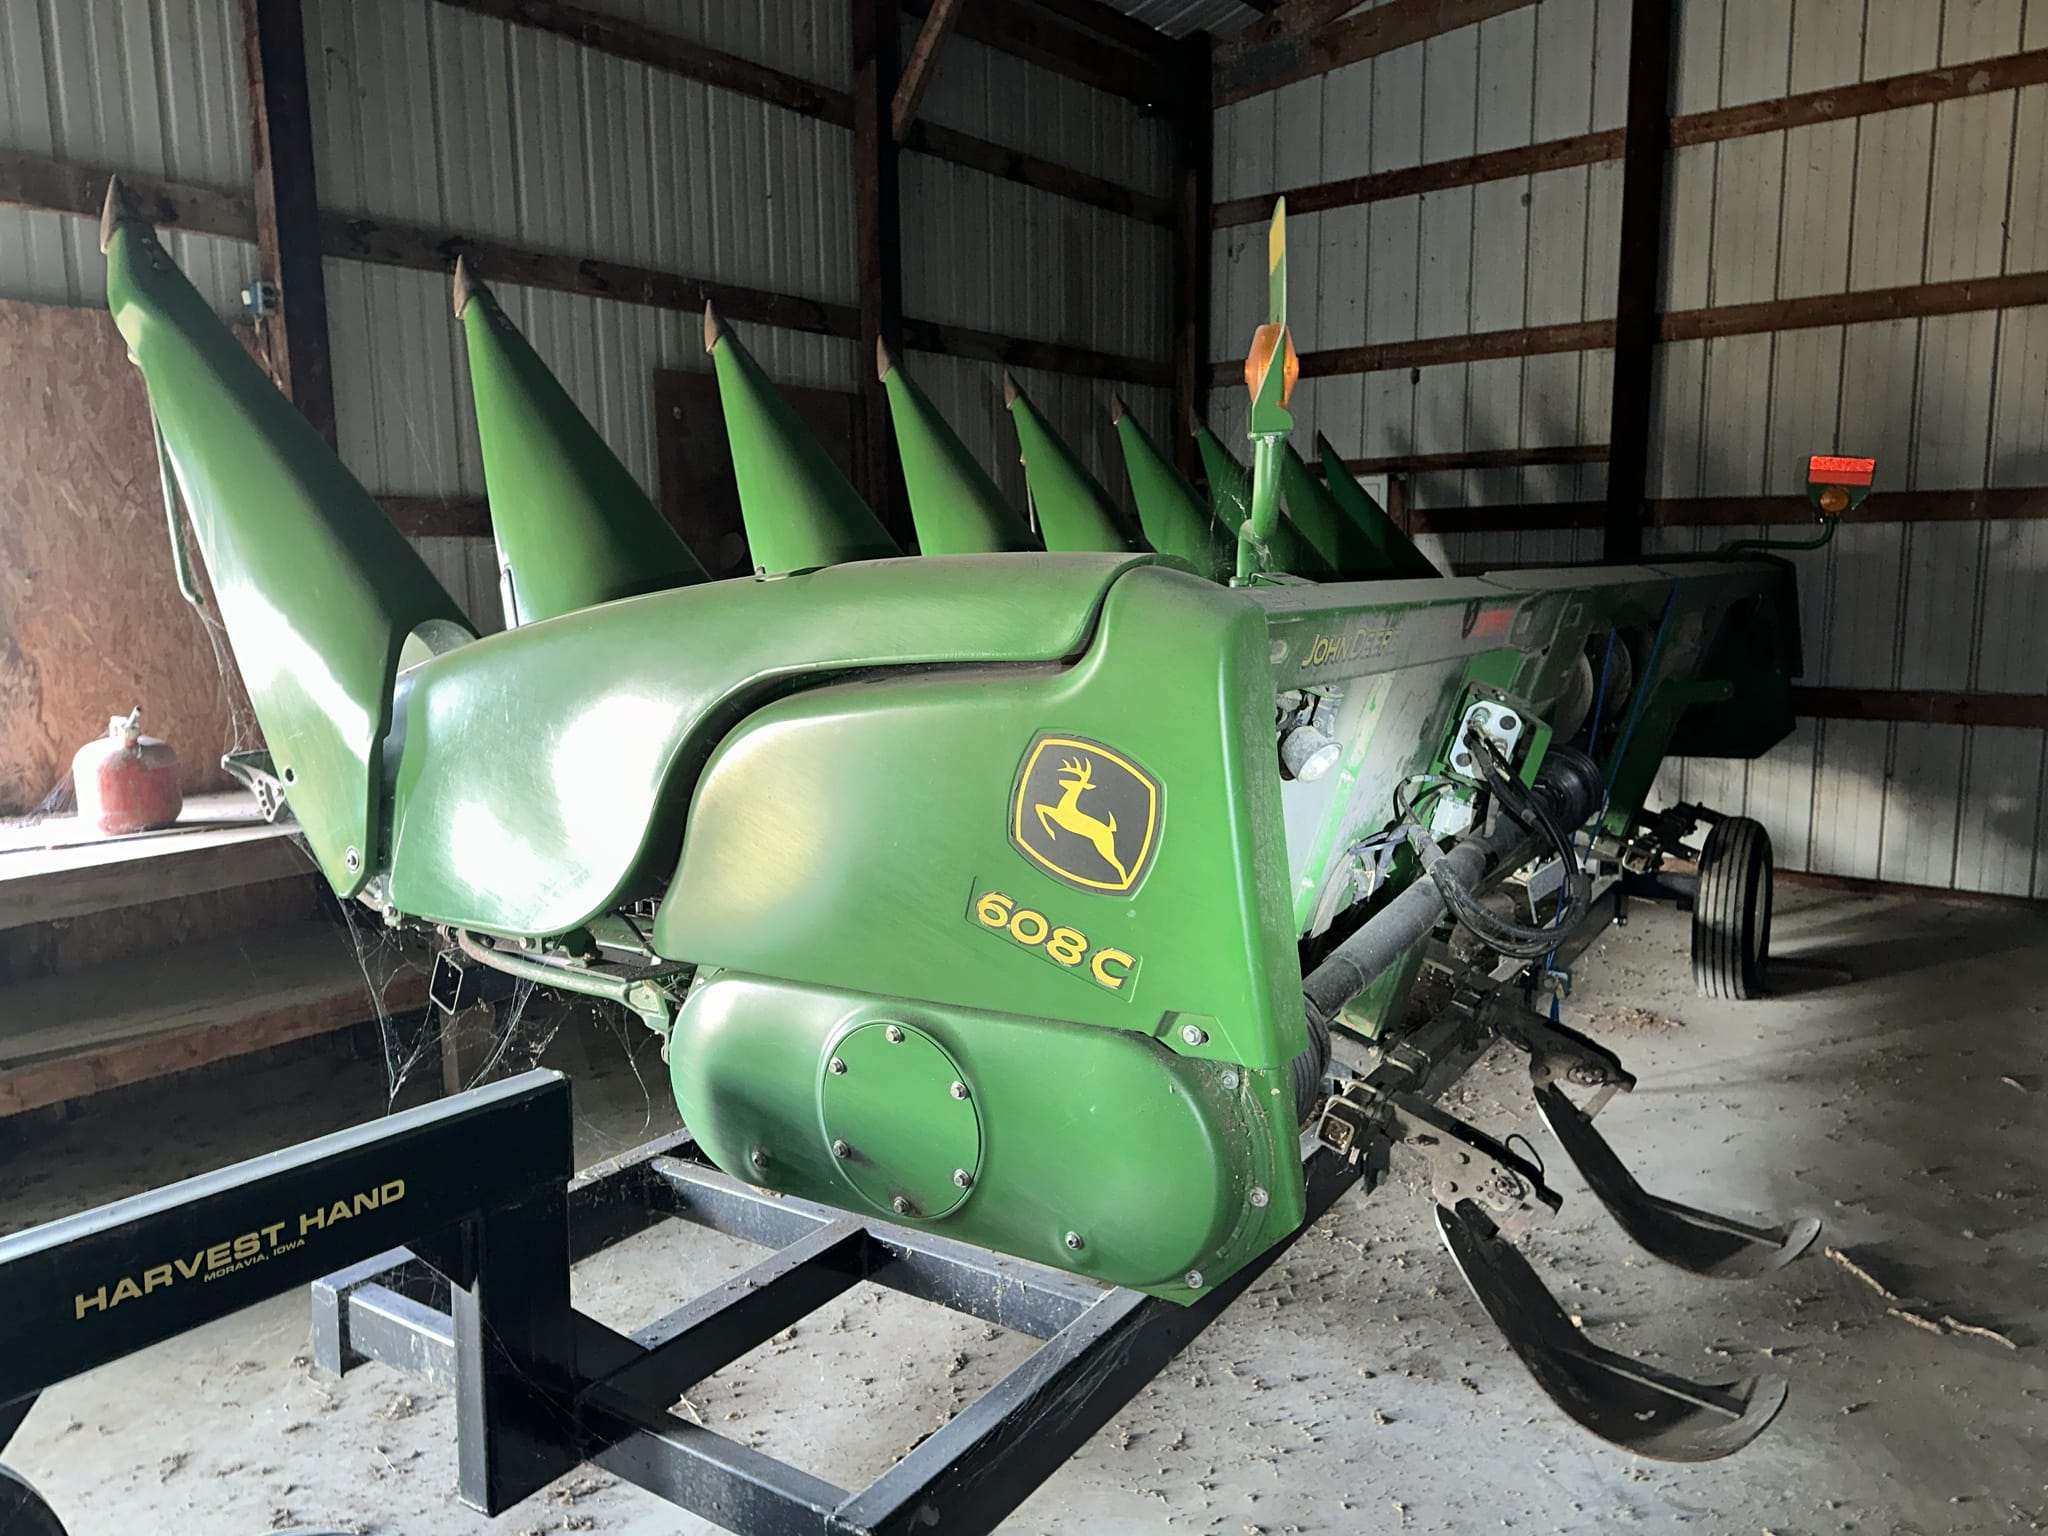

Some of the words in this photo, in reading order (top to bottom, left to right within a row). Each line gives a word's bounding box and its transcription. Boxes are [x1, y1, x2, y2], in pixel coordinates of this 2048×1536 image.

[1301, 634, 1350, 668] JOHN
[1350, 626, 1397, 660] DEER
[75, 1222, 285, 1320] HARVEST
[299, 1179, 405, 1235] HAND
[204, 1253, 270, 1282] MORAVIA,
[273, 1238, 306, 1256] IOWA
